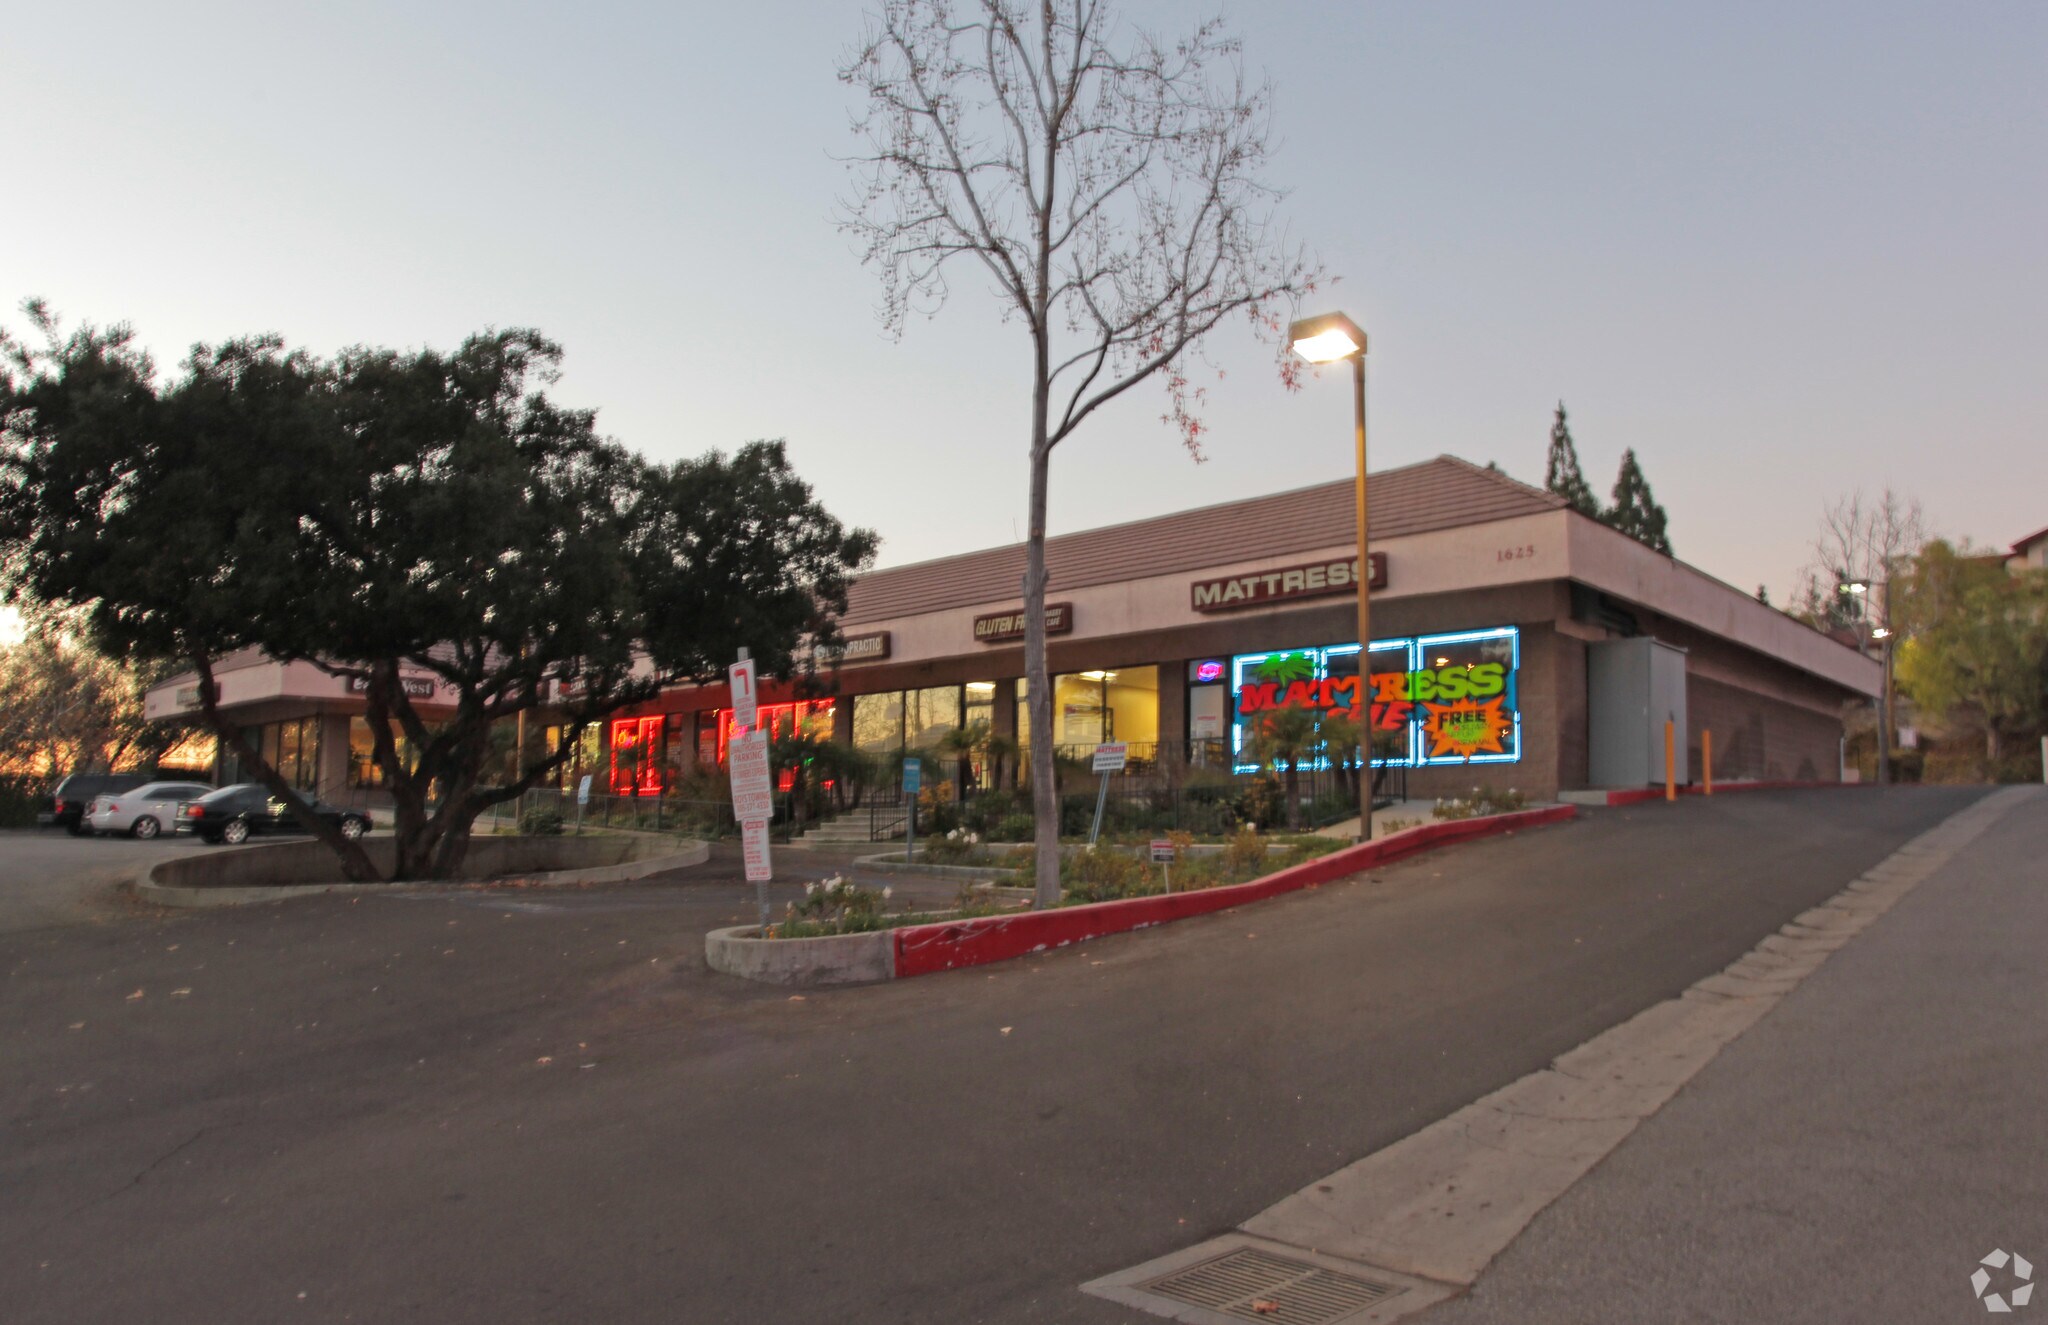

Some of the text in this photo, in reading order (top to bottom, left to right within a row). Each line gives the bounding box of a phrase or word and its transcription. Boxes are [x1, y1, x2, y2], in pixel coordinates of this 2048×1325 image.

[1194, 558, 1376, 606] MATTRESS
[976, 615, 1013, 636] GLUTEN
[1239, 662, 1506, 714] MATTRESS
[1438, 708, 1487, 732] FREE
[742, 732, 752, 744] NO
[734, 751, 763, 762] PARKING
